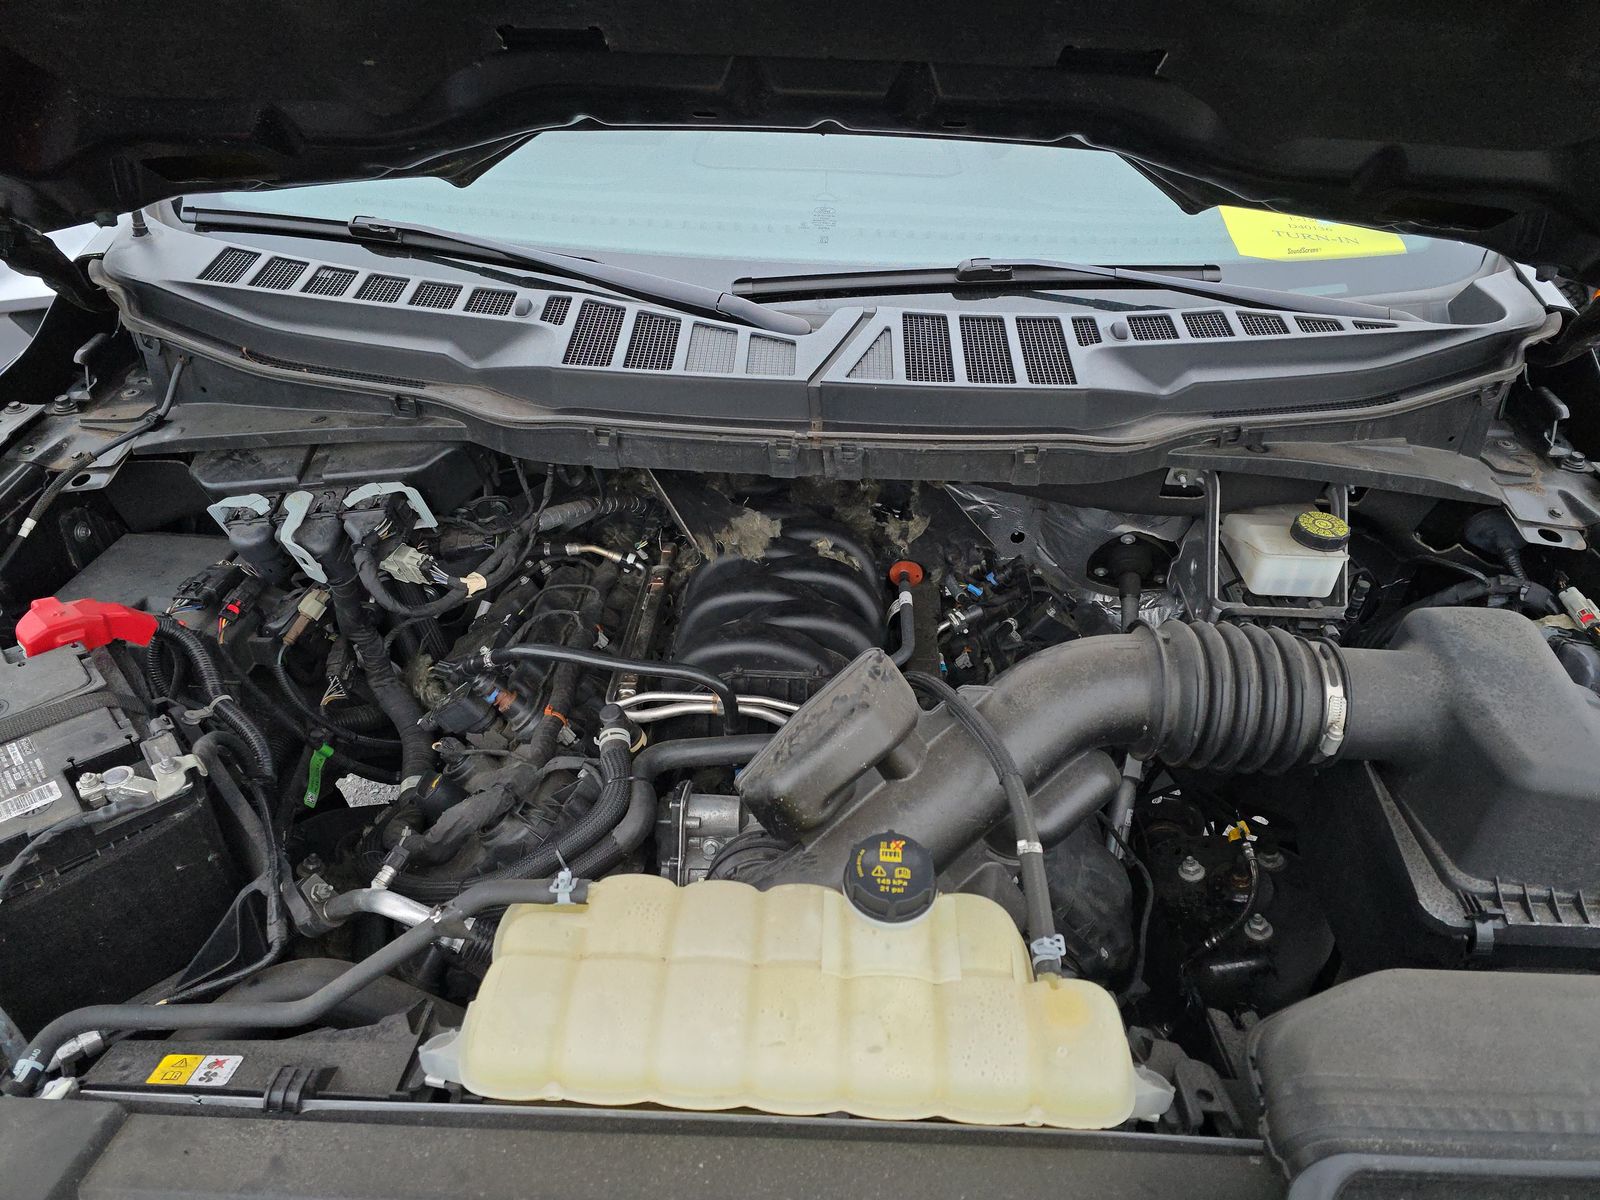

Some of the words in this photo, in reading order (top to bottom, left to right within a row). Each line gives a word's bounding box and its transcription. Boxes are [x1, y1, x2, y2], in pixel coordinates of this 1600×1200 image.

[1272, 229, 1360, 245] TURN-IN
[879, 885, 890, 893] 21
[891, 886, 904, 895] psi
